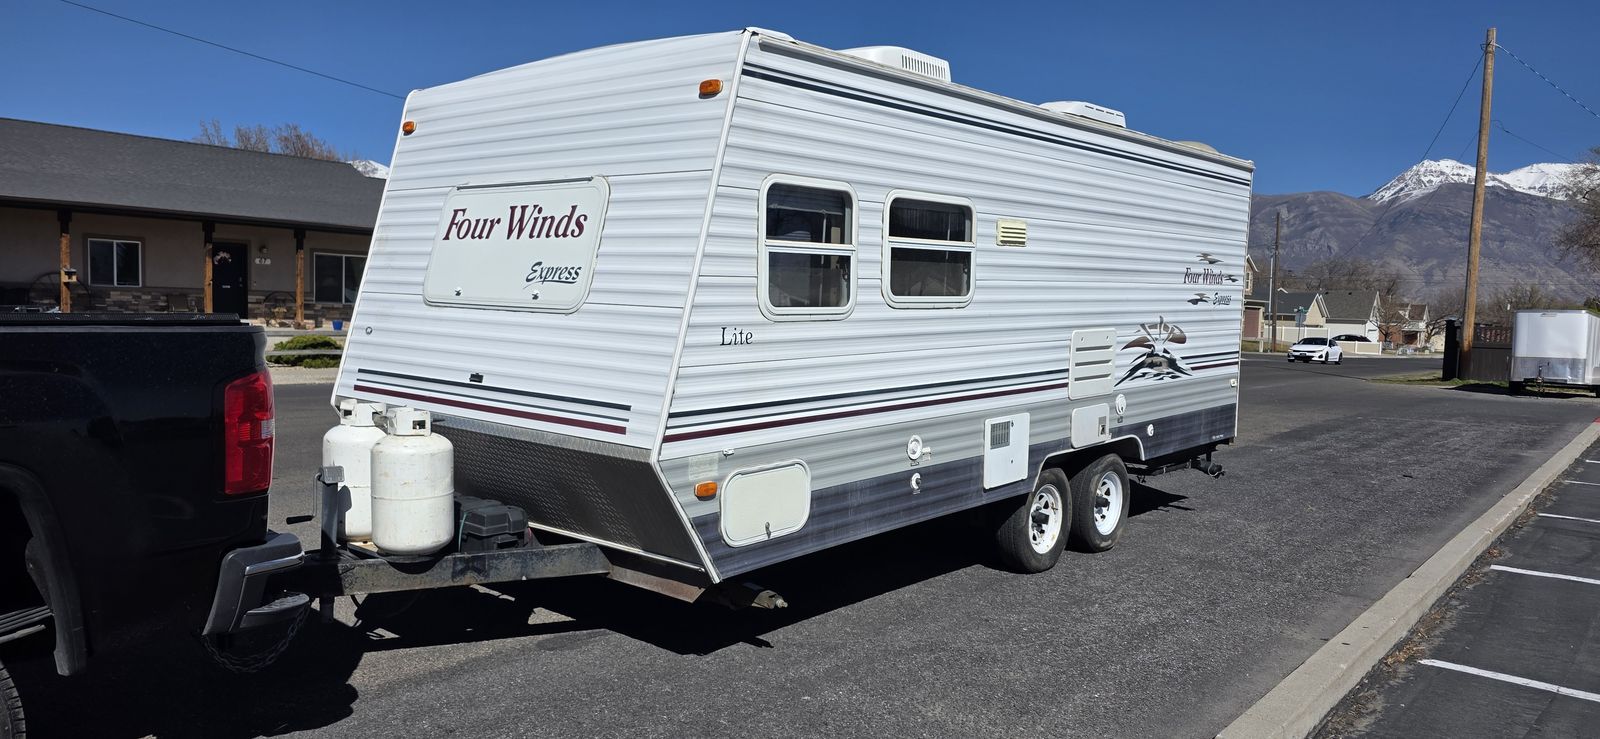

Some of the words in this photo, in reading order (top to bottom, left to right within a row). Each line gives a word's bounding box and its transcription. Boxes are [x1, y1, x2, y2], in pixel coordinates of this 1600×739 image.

[442, 208, 502, 241] Four
[506, 204, 588, 240] Winds
[525, 261, 583, 285] Express
[1183, 267, 1203, 284] Four
[1202, 268, 1225, 286] Winds
[719, 326, 753, 346] Lite
